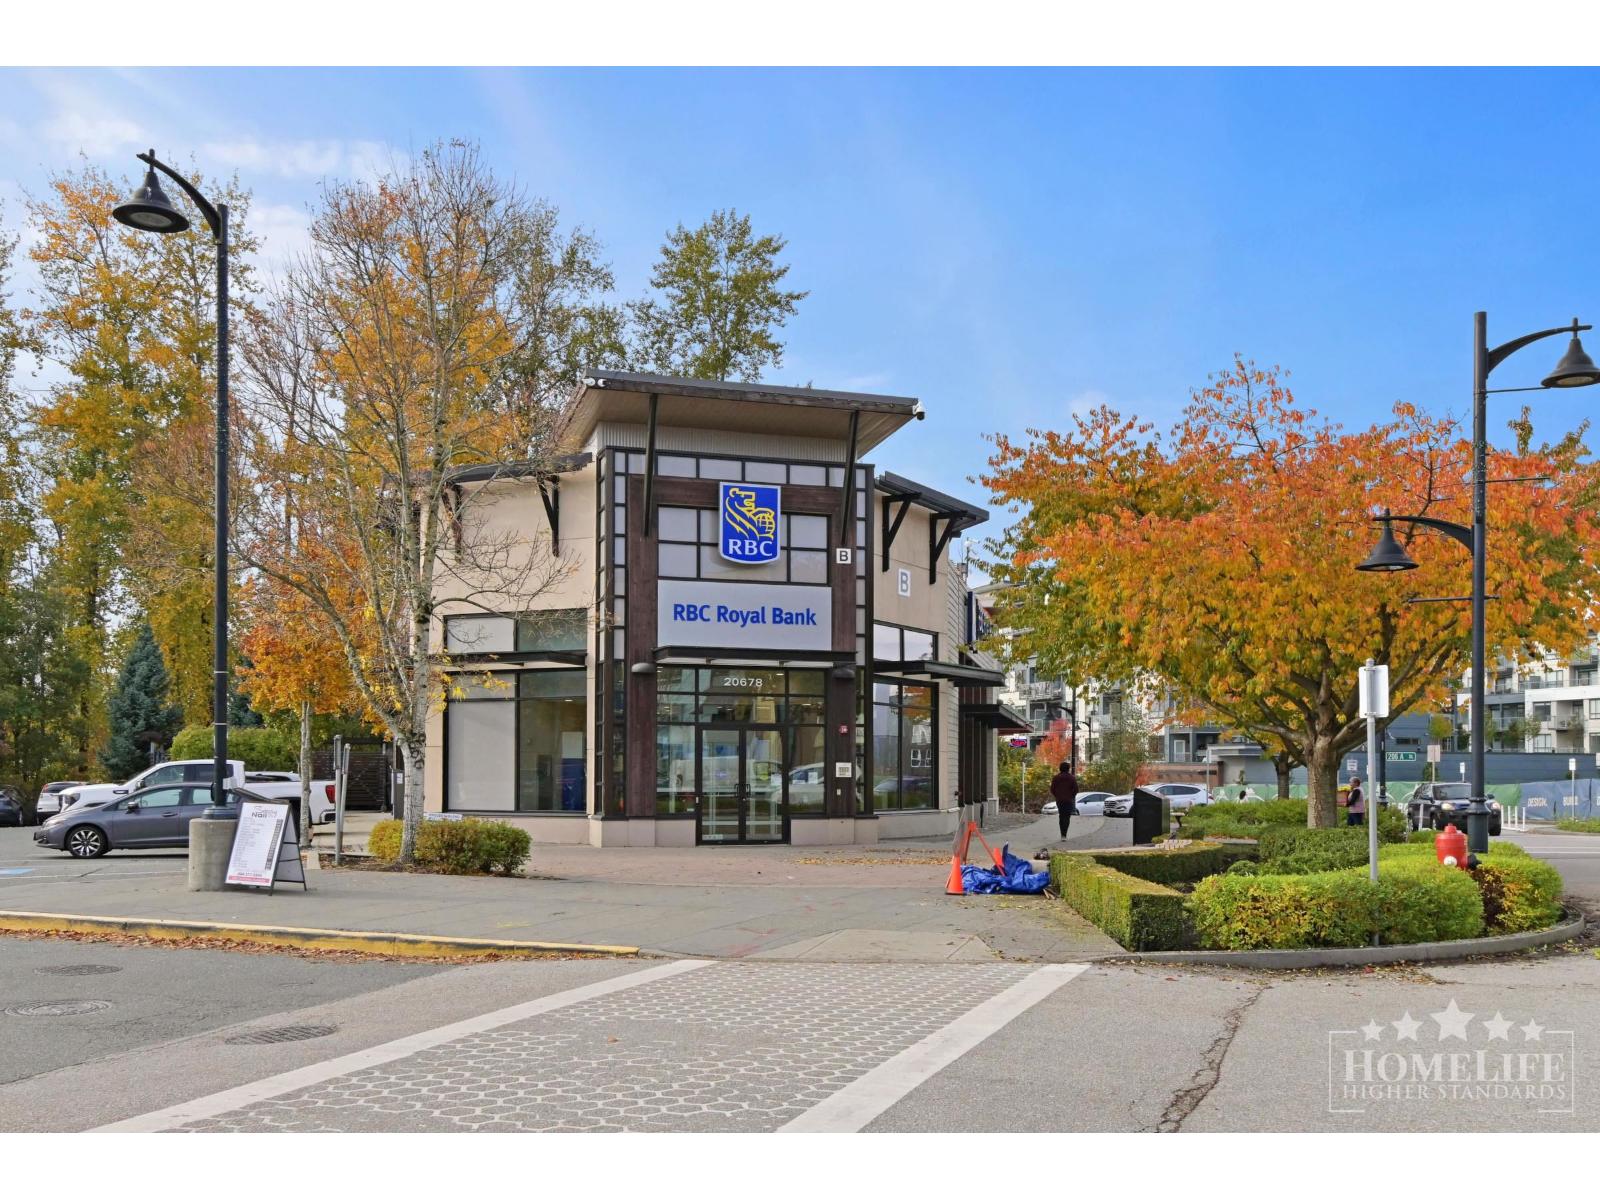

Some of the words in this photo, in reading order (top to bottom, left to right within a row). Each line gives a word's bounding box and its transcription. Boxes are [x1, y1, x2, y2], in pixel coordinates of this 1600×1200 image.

[728, 539, 773, 557] RBC
[839, 550, 849, 562] B
[900, 572, 909, 593] B
[673, 603, 711, 622] RBC
[716, 605, 766, 628] Royal
[771, 607, 817, 626] Bank
[723, 677, 763, 687] 20678
